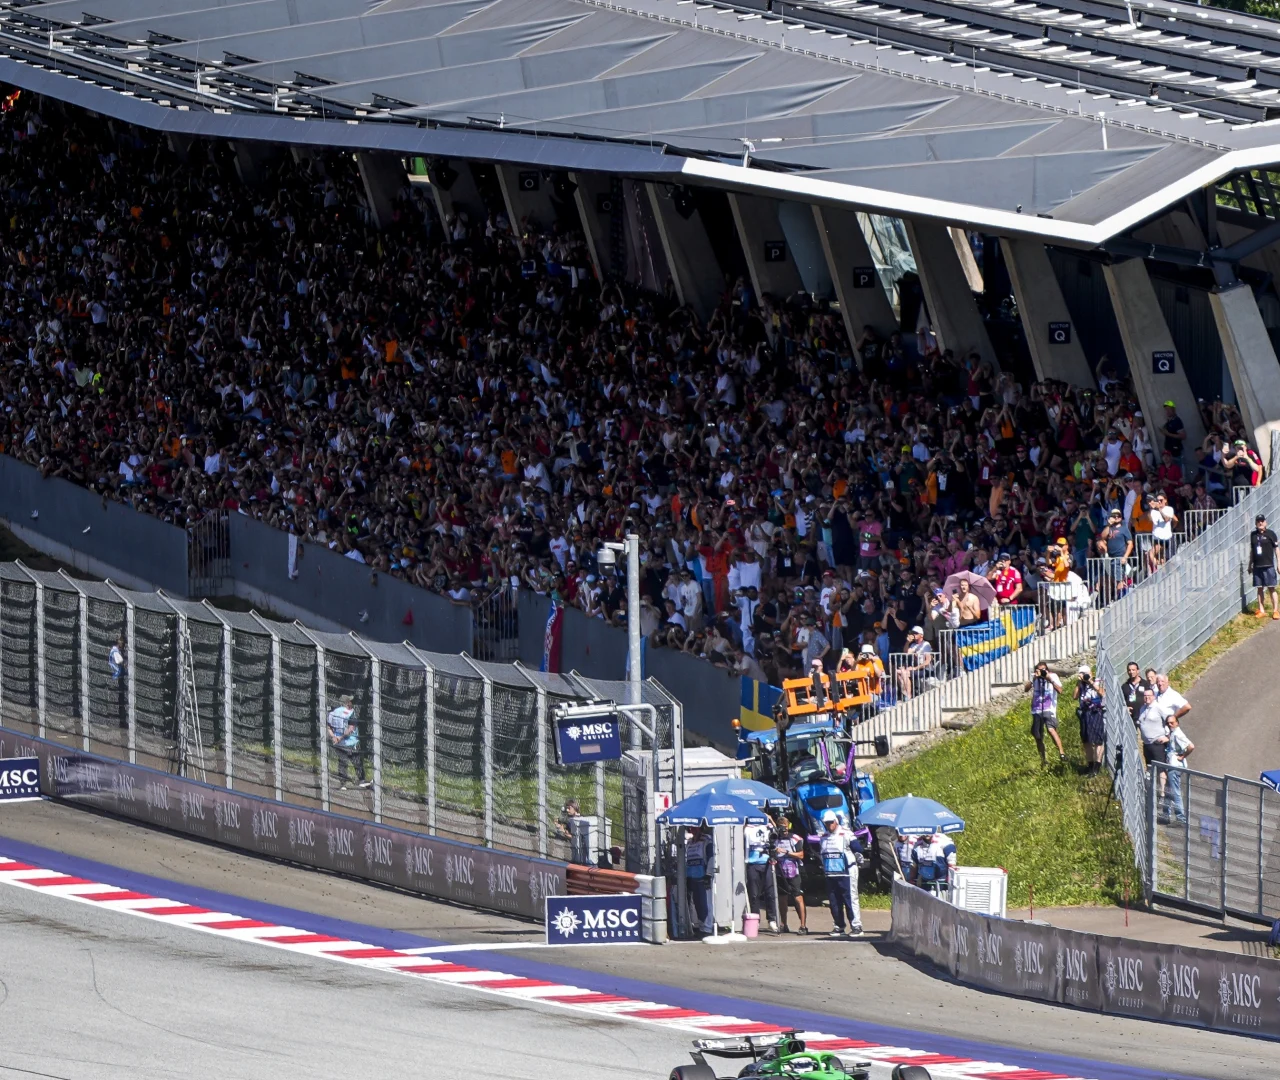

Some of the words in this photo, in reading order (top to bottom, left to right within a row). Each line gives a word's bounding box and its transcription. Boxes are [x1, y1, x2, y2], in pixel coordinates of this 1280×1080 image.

[771, 248, 780, 259] P
[860, 274, 868, 286] P
[1054, 330, 1066, 341] Q
[1158, 359, 1170, 371] Q
[582, 722, 612, 735] MSC
[118, 773, 135, 801] MSC
[152, 782, 170, 811] MSC
[188, 792, 205, 820] MSC
[223, 801, 241, 829] MSC
[260, 810, 278, 839] MSC
[296, 818, 315, 846] MSC
[336, 828, 355, 856] MSC
[374, 836, 393, 866] MSC
[414, 845, 433, 876] MSC
[454, 854, 474, 885] MSC
[498, 864, 517, 894] MSC
[583, 908, 638, 929] MSC
[583, 930, 639, 939] CRUISES
[985, 933, 1002, 966] MSC
[1024, 941, 1044, 974] MSC
[1066, 948, 1087, 982] MSC
[1118, 958, 1143, 991] MSC
[1173, 964, 1200, 1000] MSC
[1232, 973, 1261, 1008] MSC
[1232, 1014, 1261, 1026] CRUISES
